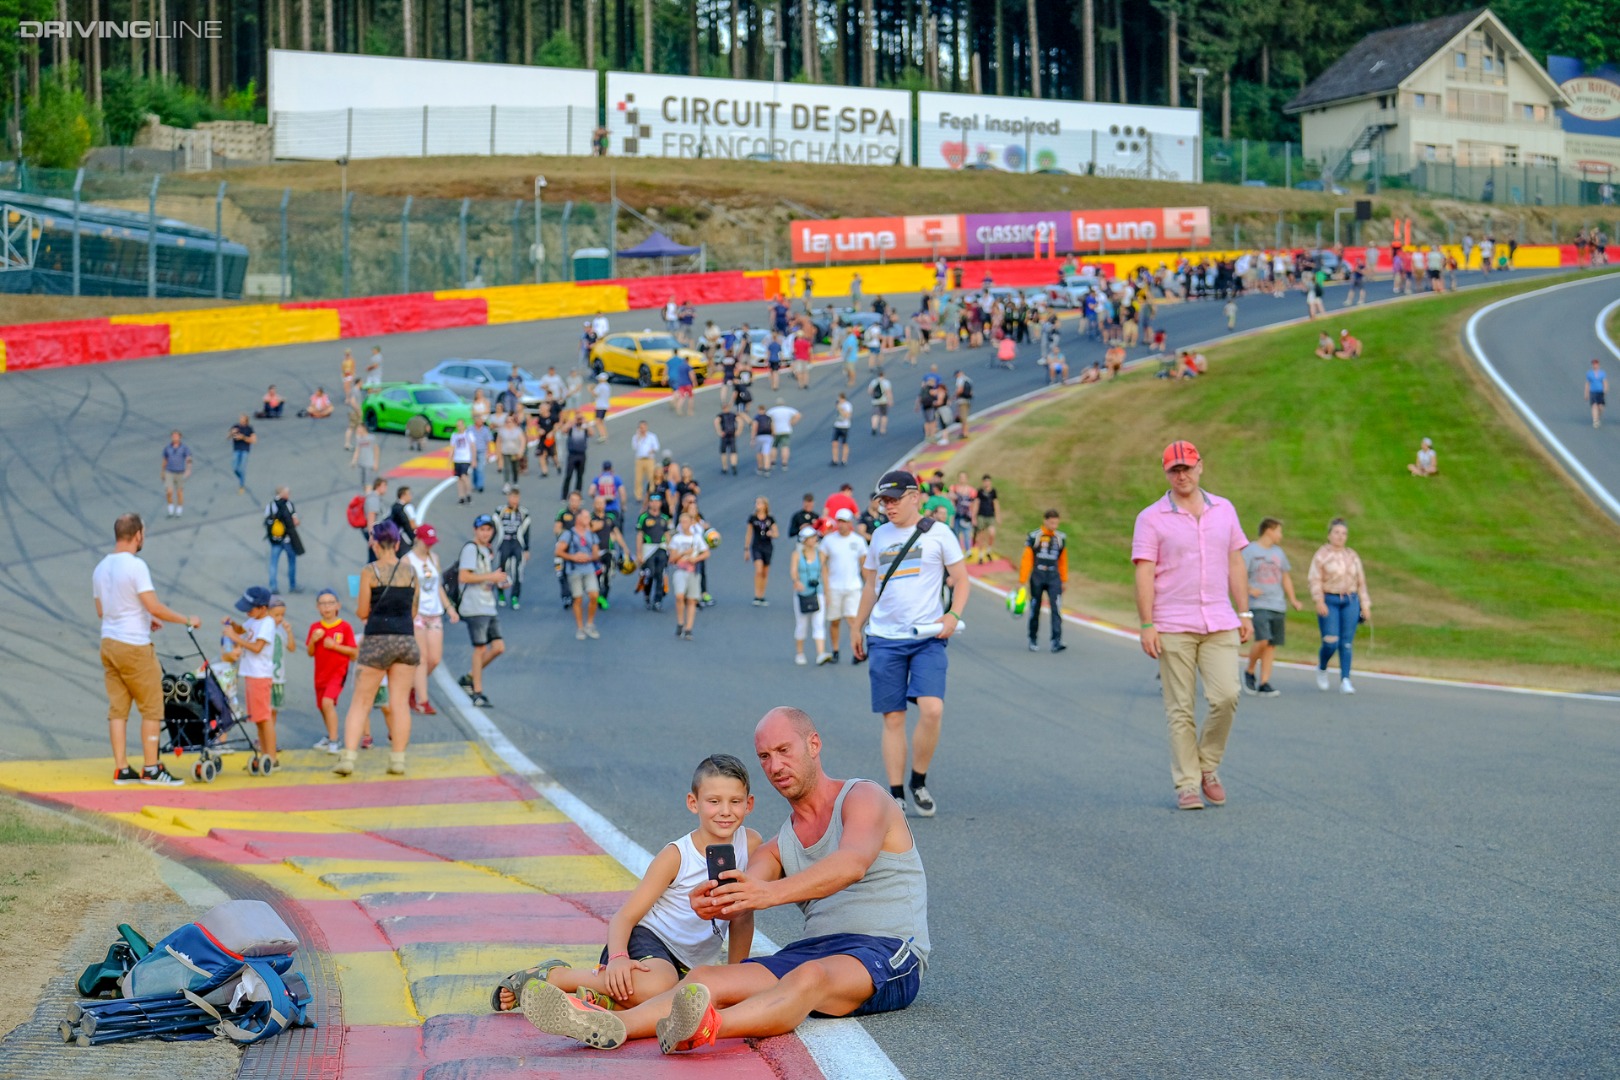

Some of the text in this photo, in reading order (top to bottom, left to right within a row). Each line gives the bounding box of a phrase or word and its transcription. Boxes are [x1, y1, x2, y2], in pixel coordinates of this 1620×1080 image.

[661, 95, 897, 135] CIRCUIT DE SPA
[939, 112, 1061, 136] Feel inspired
[662, 131, 898, 165] FRANCORCHAMPS
[802, 227, 896, 252] la une
[1077, 217, 1156, 242] la une
